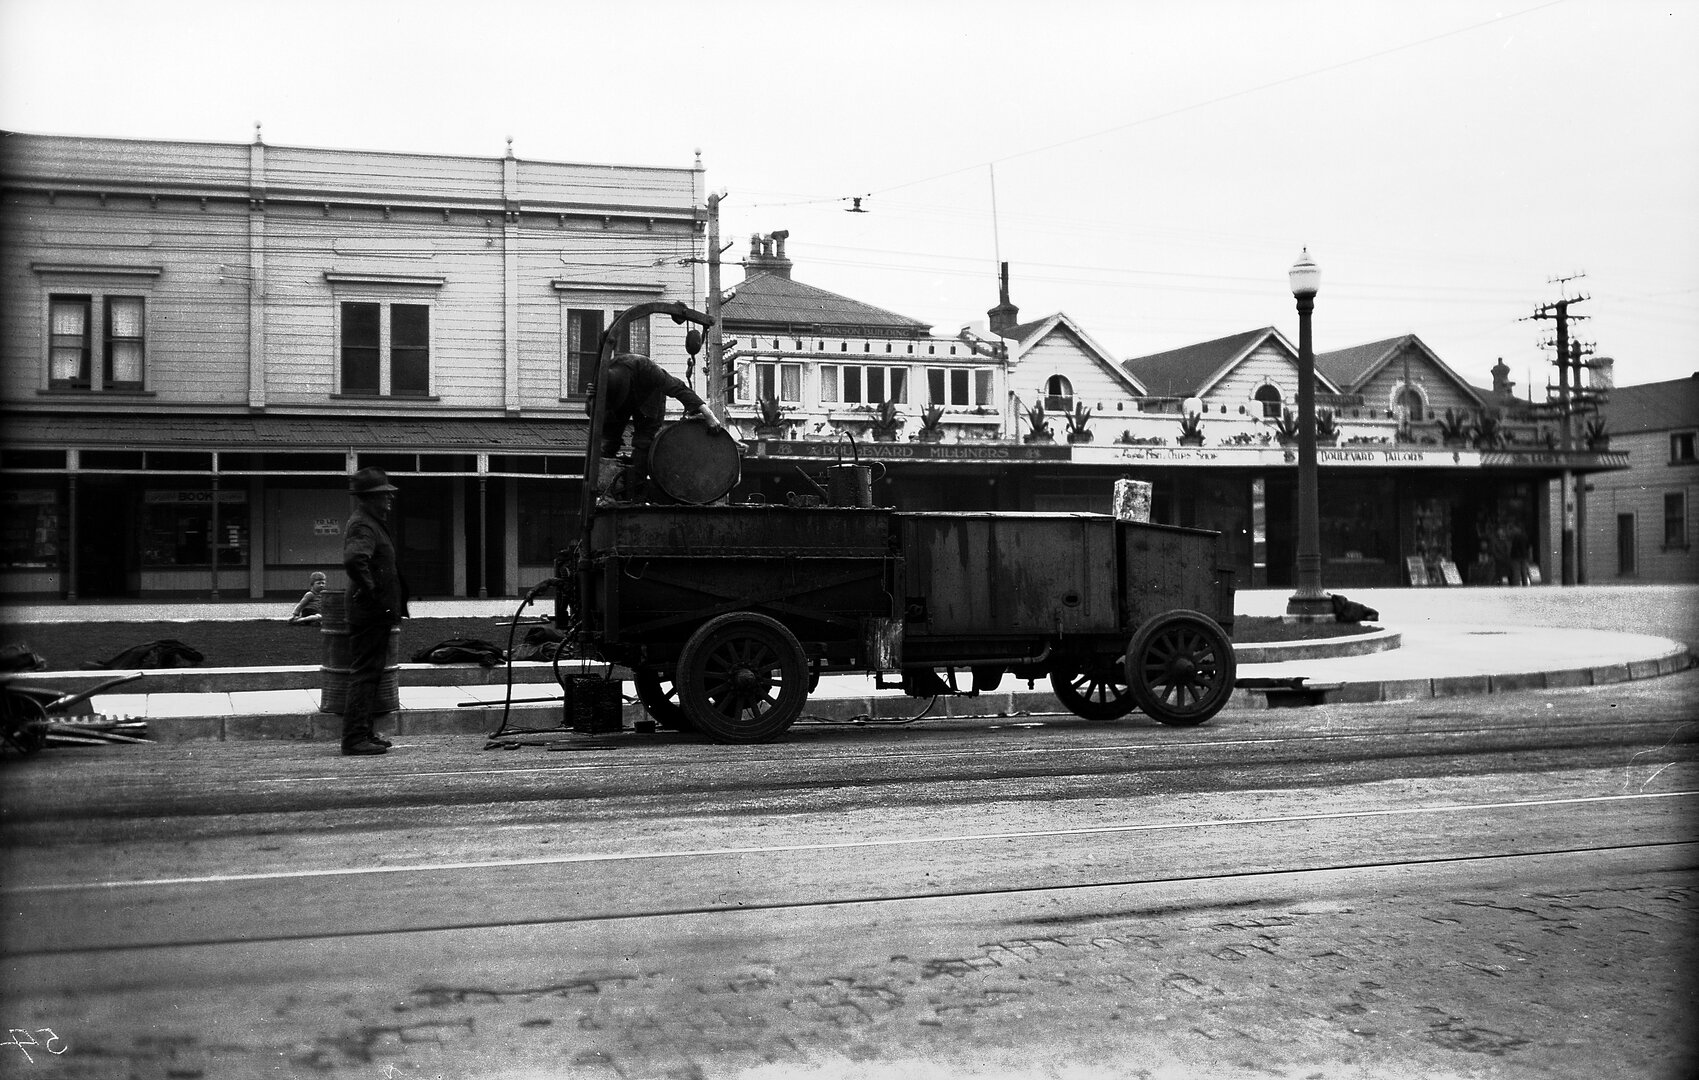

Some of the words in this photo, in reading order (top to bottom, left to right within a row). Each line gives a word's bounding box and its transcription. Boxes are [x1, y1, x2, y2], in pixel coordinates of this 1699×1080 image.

[863, 327, 910, 337] BUILDING
[823, 446, 914, 457] BOULEVARD
[930, 447, 1010, 458] MILLINERS
